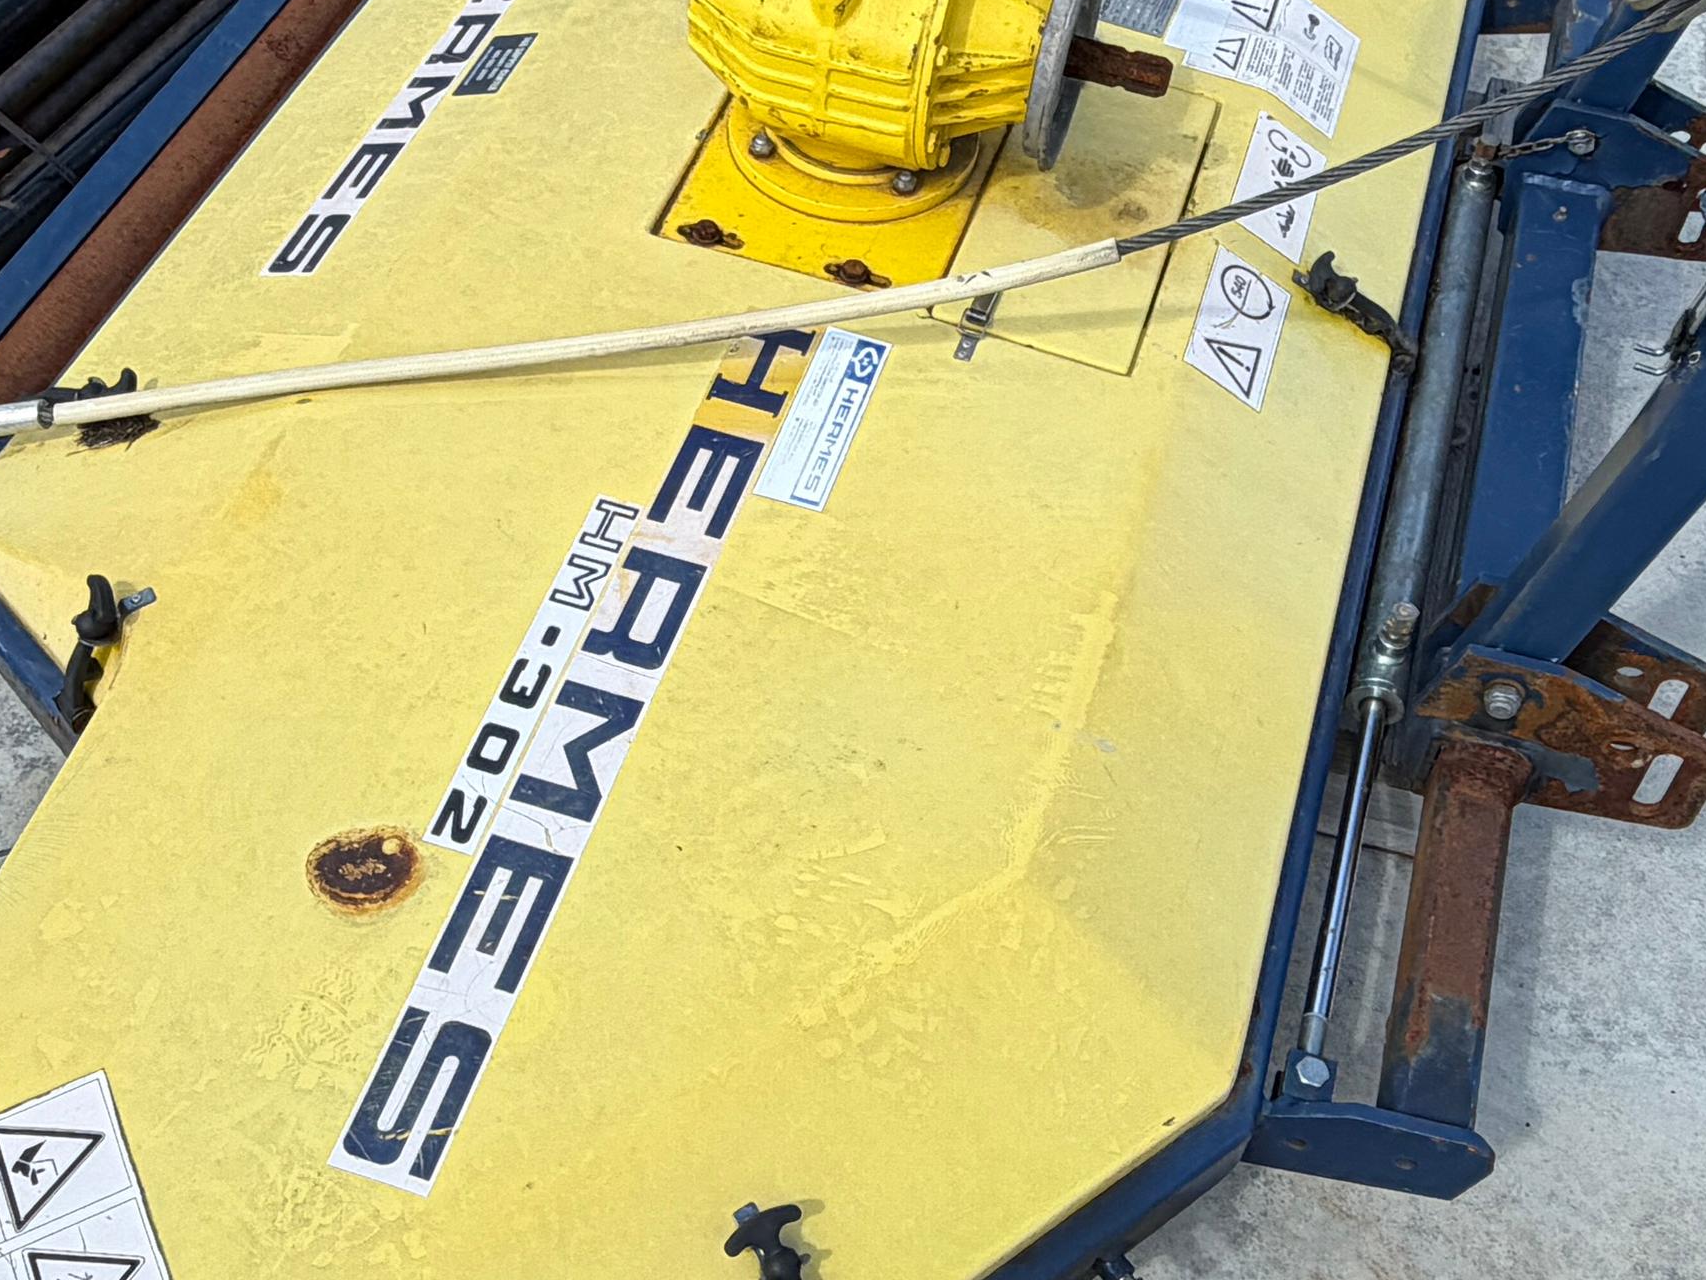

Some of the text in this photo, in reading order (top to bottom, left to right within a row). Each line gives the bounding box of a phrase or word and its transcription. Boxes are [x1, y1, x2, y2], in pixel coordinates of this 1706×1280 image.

[804, 387, 858, 493] HERMES
[341, 330, 816, 1181] HERMES
[430, 498, 639, 846] HM-302
